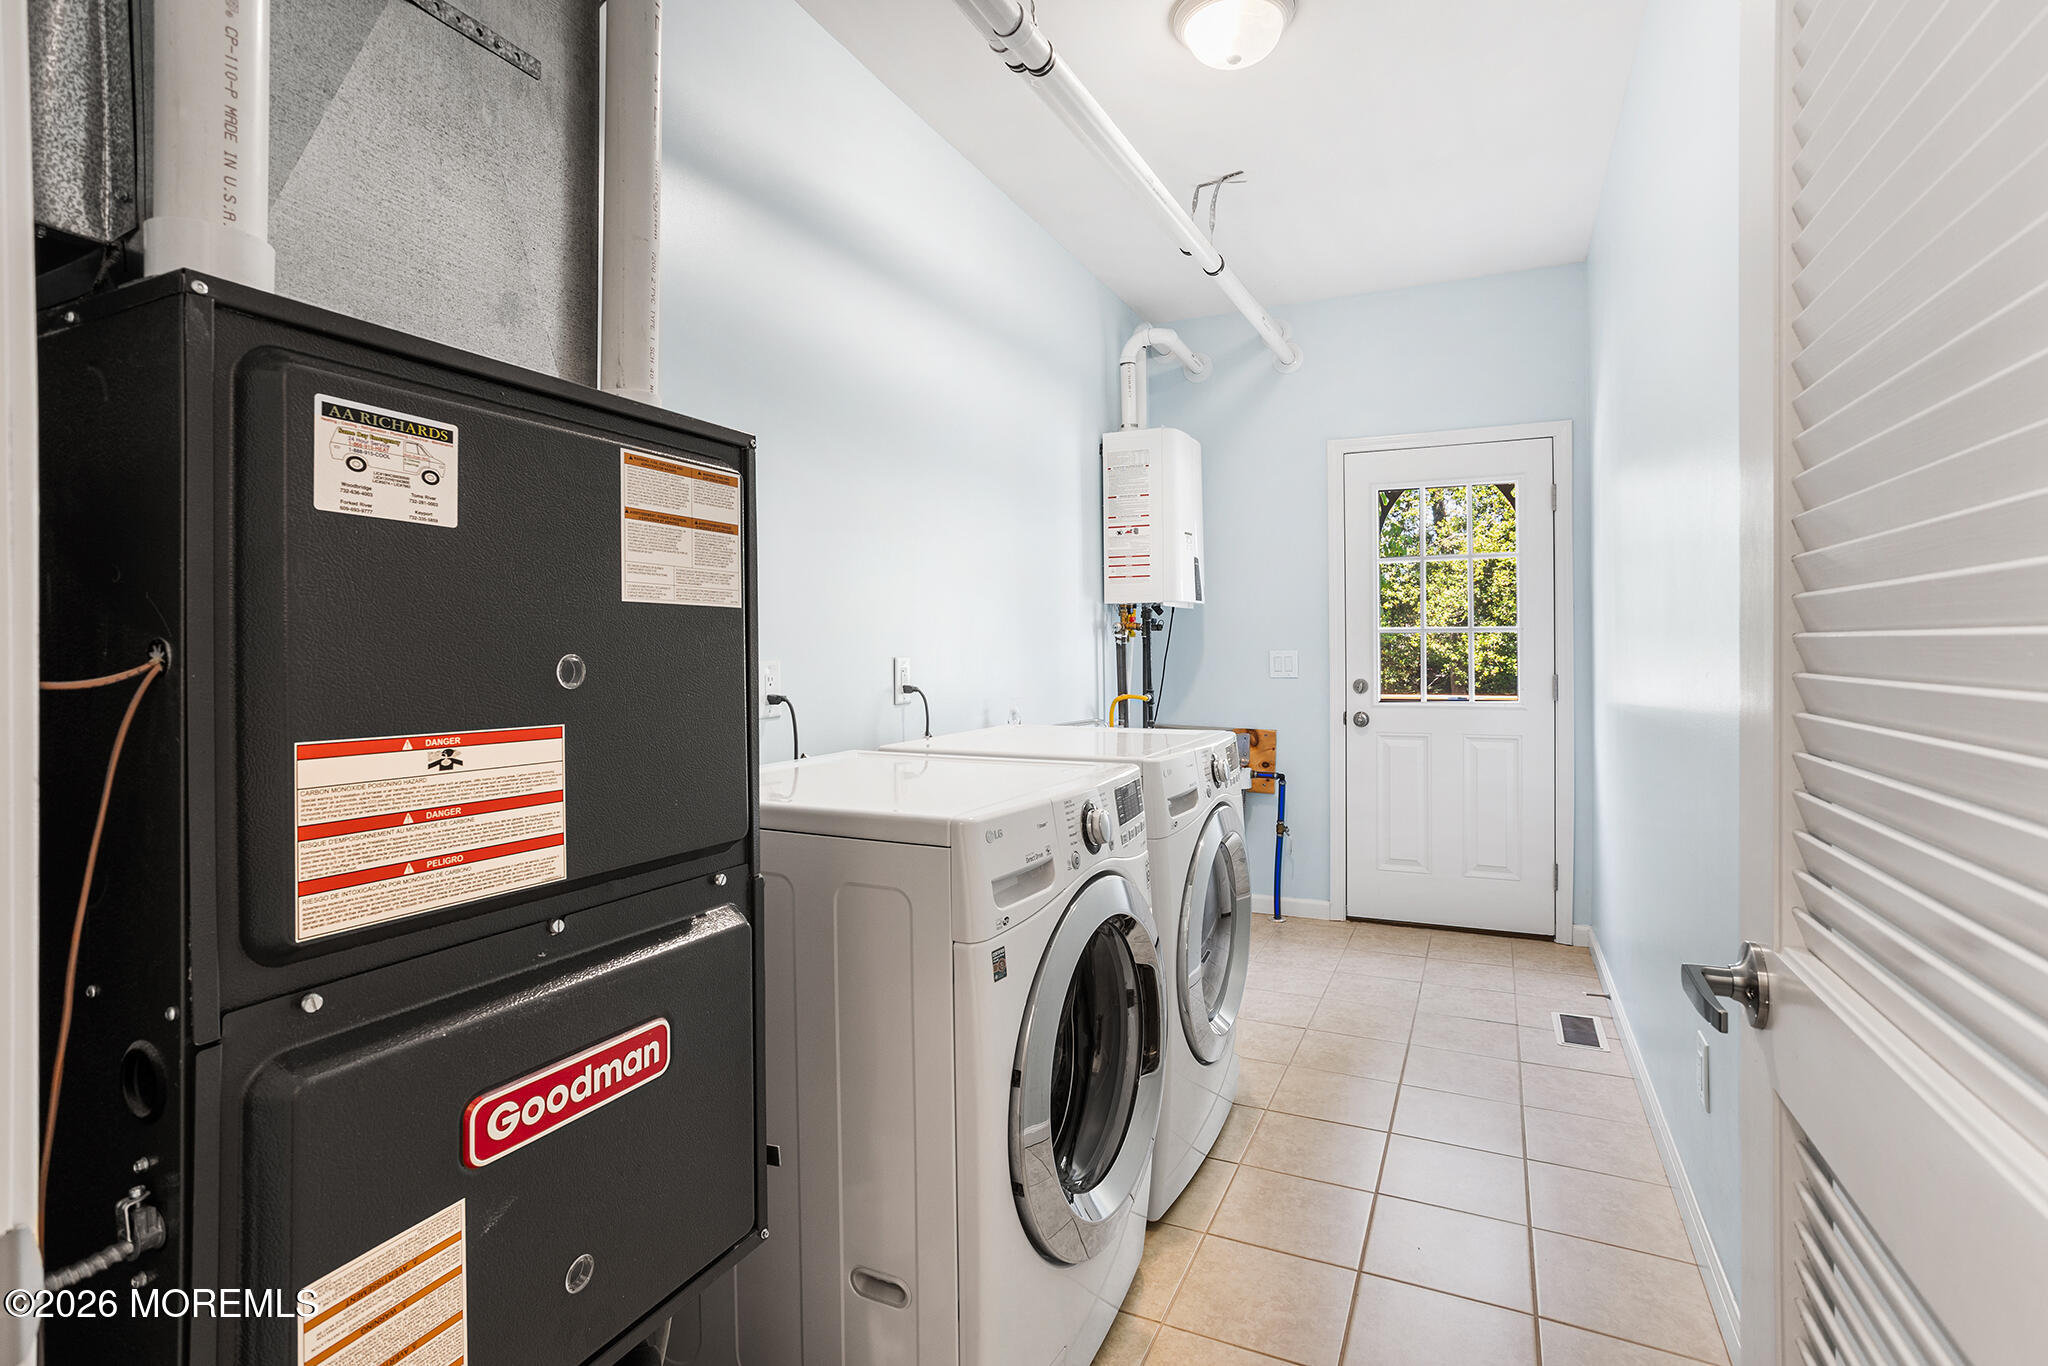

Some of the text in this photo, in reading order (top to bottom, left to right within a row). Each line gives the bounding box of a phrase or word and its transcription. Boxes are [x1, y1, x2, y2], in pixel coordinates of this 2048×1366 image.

[224, 26, 238, 99] CP-110-P
[224, 104, 238, 142] MADE
[224, 150, 238, 170] IN
[224, 176, 237, 226] U.S.A.
[329, 406, 448, 441] AA RICHARDS
[342, 482, 372, 492] Woodbridge
[425, 736, 461, 747] DANGER
[300, 777, 427, 797] CARBON MONOXIDE POISONING HAZARD
[426, 806, 462, 820] DANGER
[300, 840, 326, 850] RISQUE
[329, 829, 394, 845] D'EMPOISONNEMENT
[449, 817, 476, 826] CARBONE
[426, 854, 464, 868] PELIGRO
[302, 895, 329, 906] RIESGO
[388, 880, 401, 888] POR
[487, 1040, 660, 1140] Goodman
[346, 1266, 408, 1307] AVERTISSEMENT
[360, 1308, 396, 1334] WARNING
